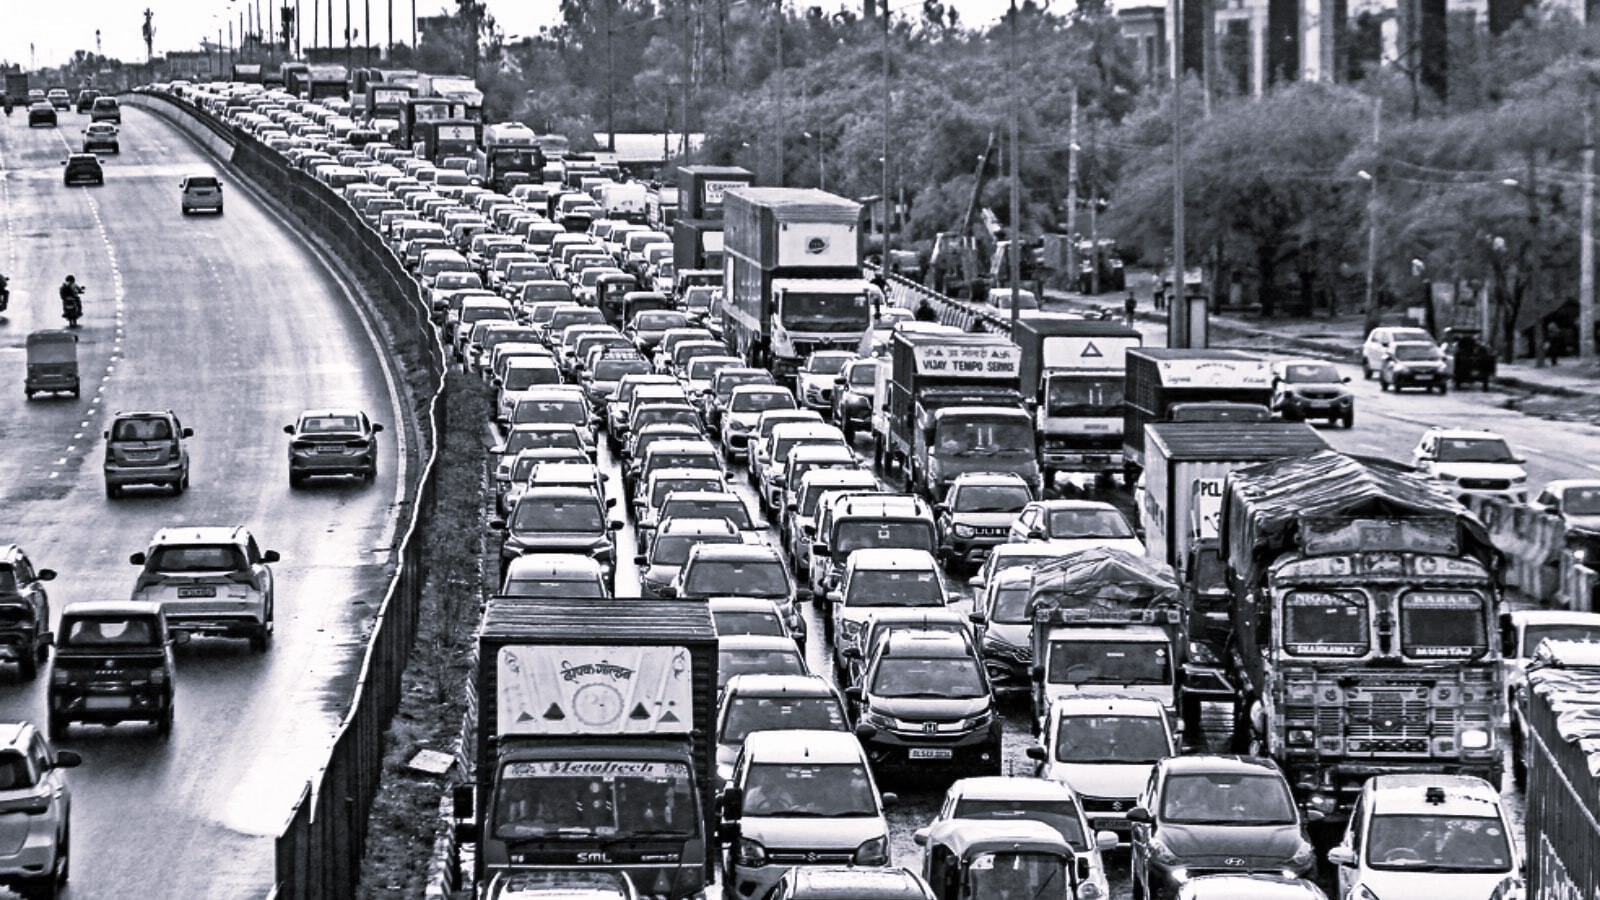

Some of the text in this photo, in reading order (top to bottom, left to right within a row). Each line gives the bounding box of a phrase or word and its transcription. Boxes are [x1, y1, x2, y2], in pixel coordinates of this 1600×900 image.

[922, 360, 947, 370] VIJAY
[952, 361, 983, 371] TEMPO
[577, 852, 612, 863] SML
